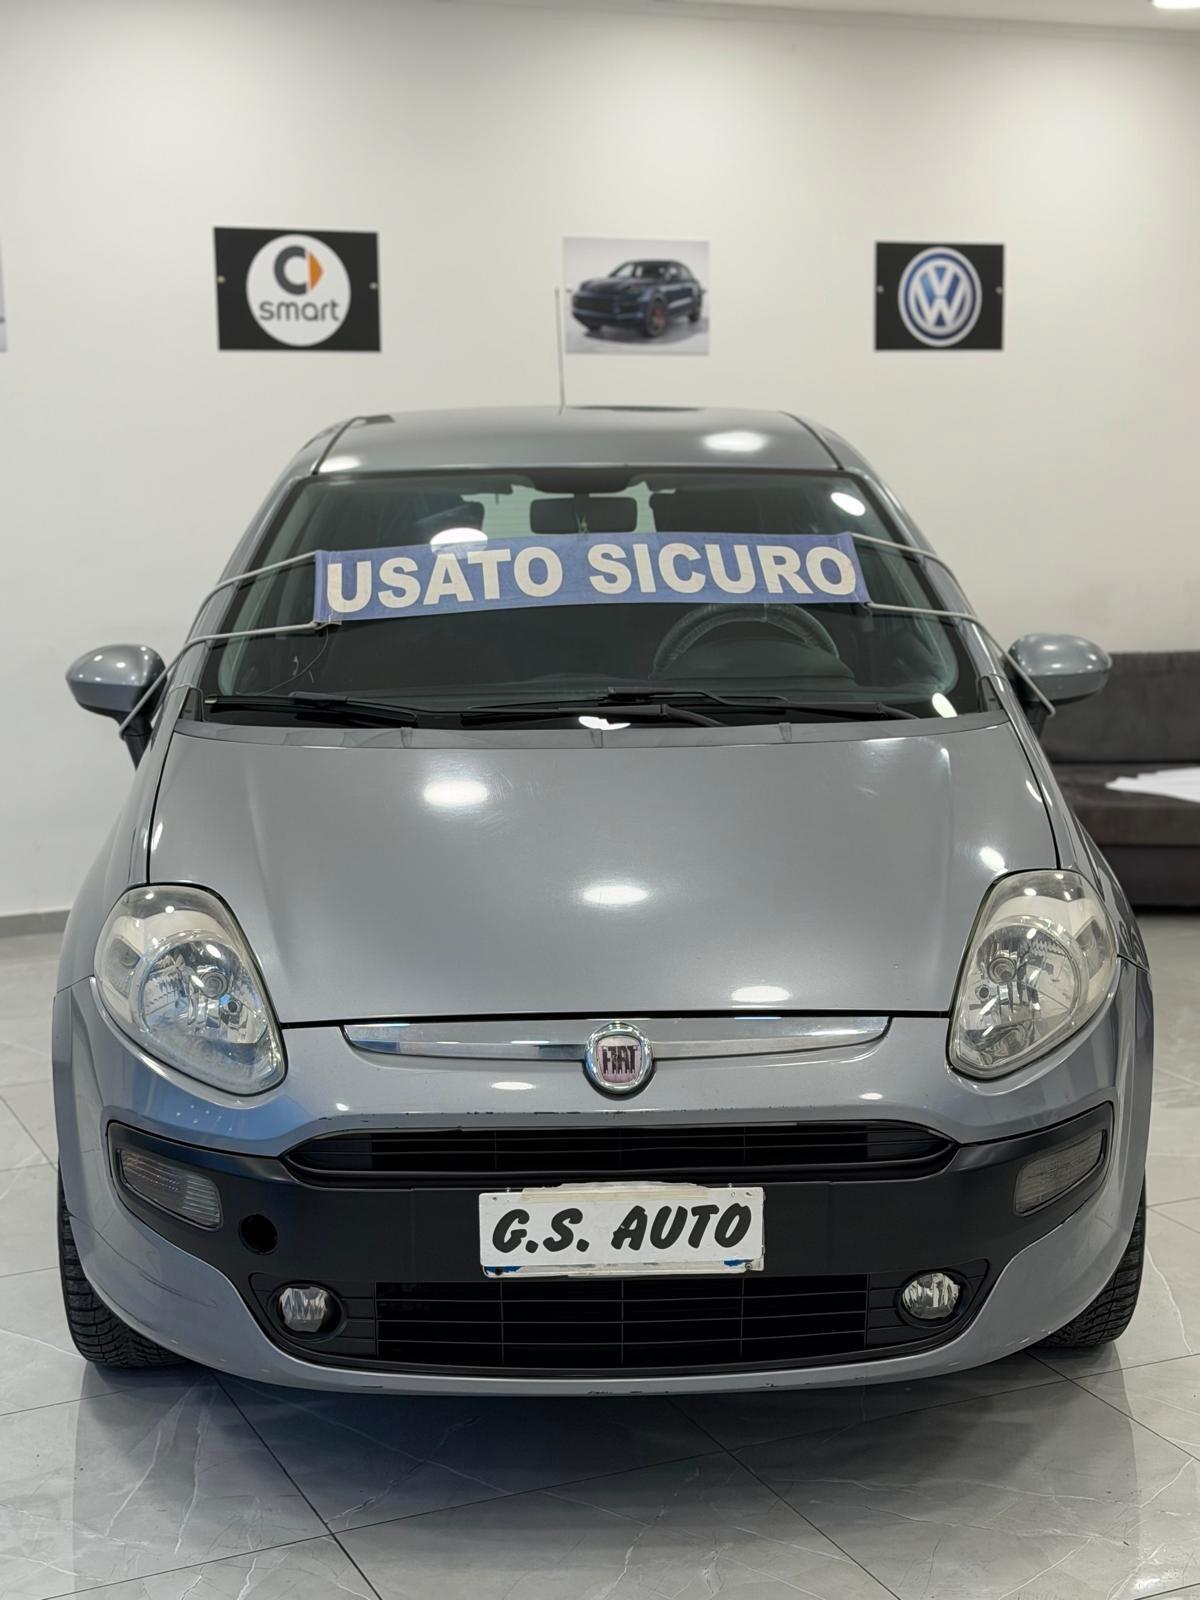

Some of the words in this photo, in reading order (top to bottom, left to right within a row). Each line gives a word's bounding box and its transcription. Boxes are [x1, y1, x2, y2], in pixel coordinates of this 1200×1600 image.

[259, 300, 339, 322] smart
[907, 256, 974, 337] VW
[327, 546, 564, 614] USATO
[587, 542, 857, 596] SICURO
[601, 1045, 638, 1074] FIAT
[491, 1208, 590, 1254] G.S.
[610, 1202, 752, 1251] AUTO
